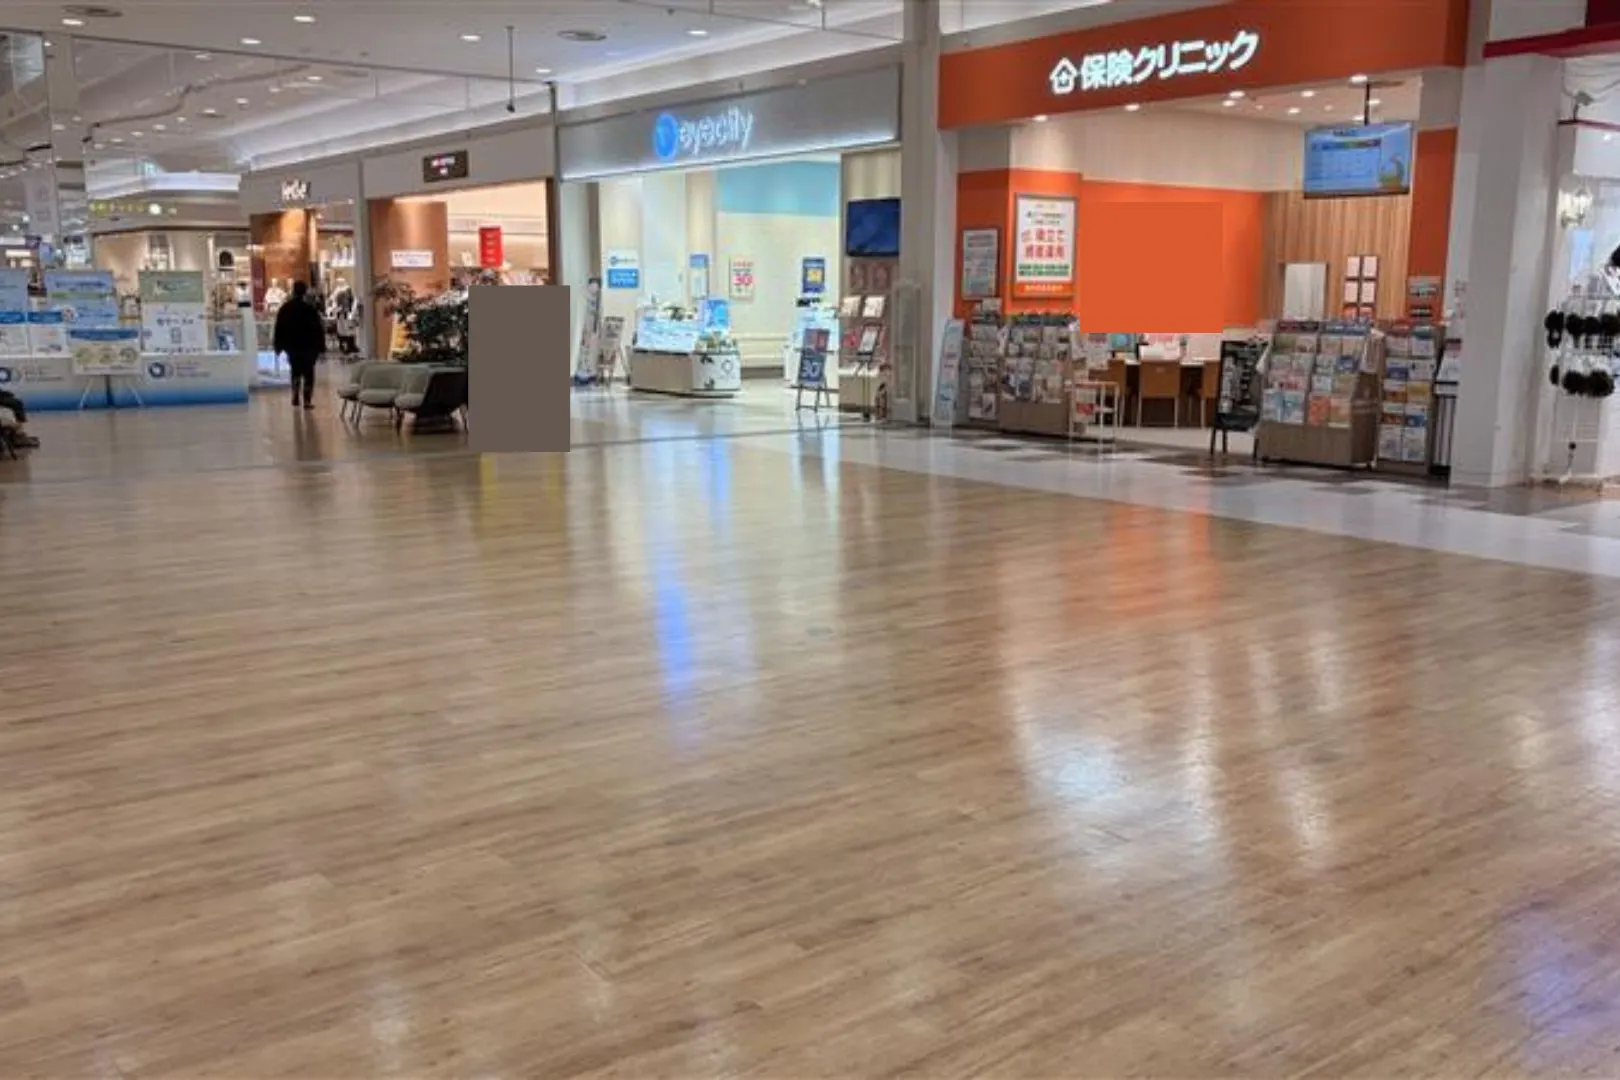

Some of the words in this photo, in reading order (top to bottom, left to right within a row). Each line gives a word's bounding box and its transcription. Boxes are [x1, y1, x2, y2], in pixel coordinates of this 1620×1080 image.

[1080, 30, 1259, 90] 保険クリニック
